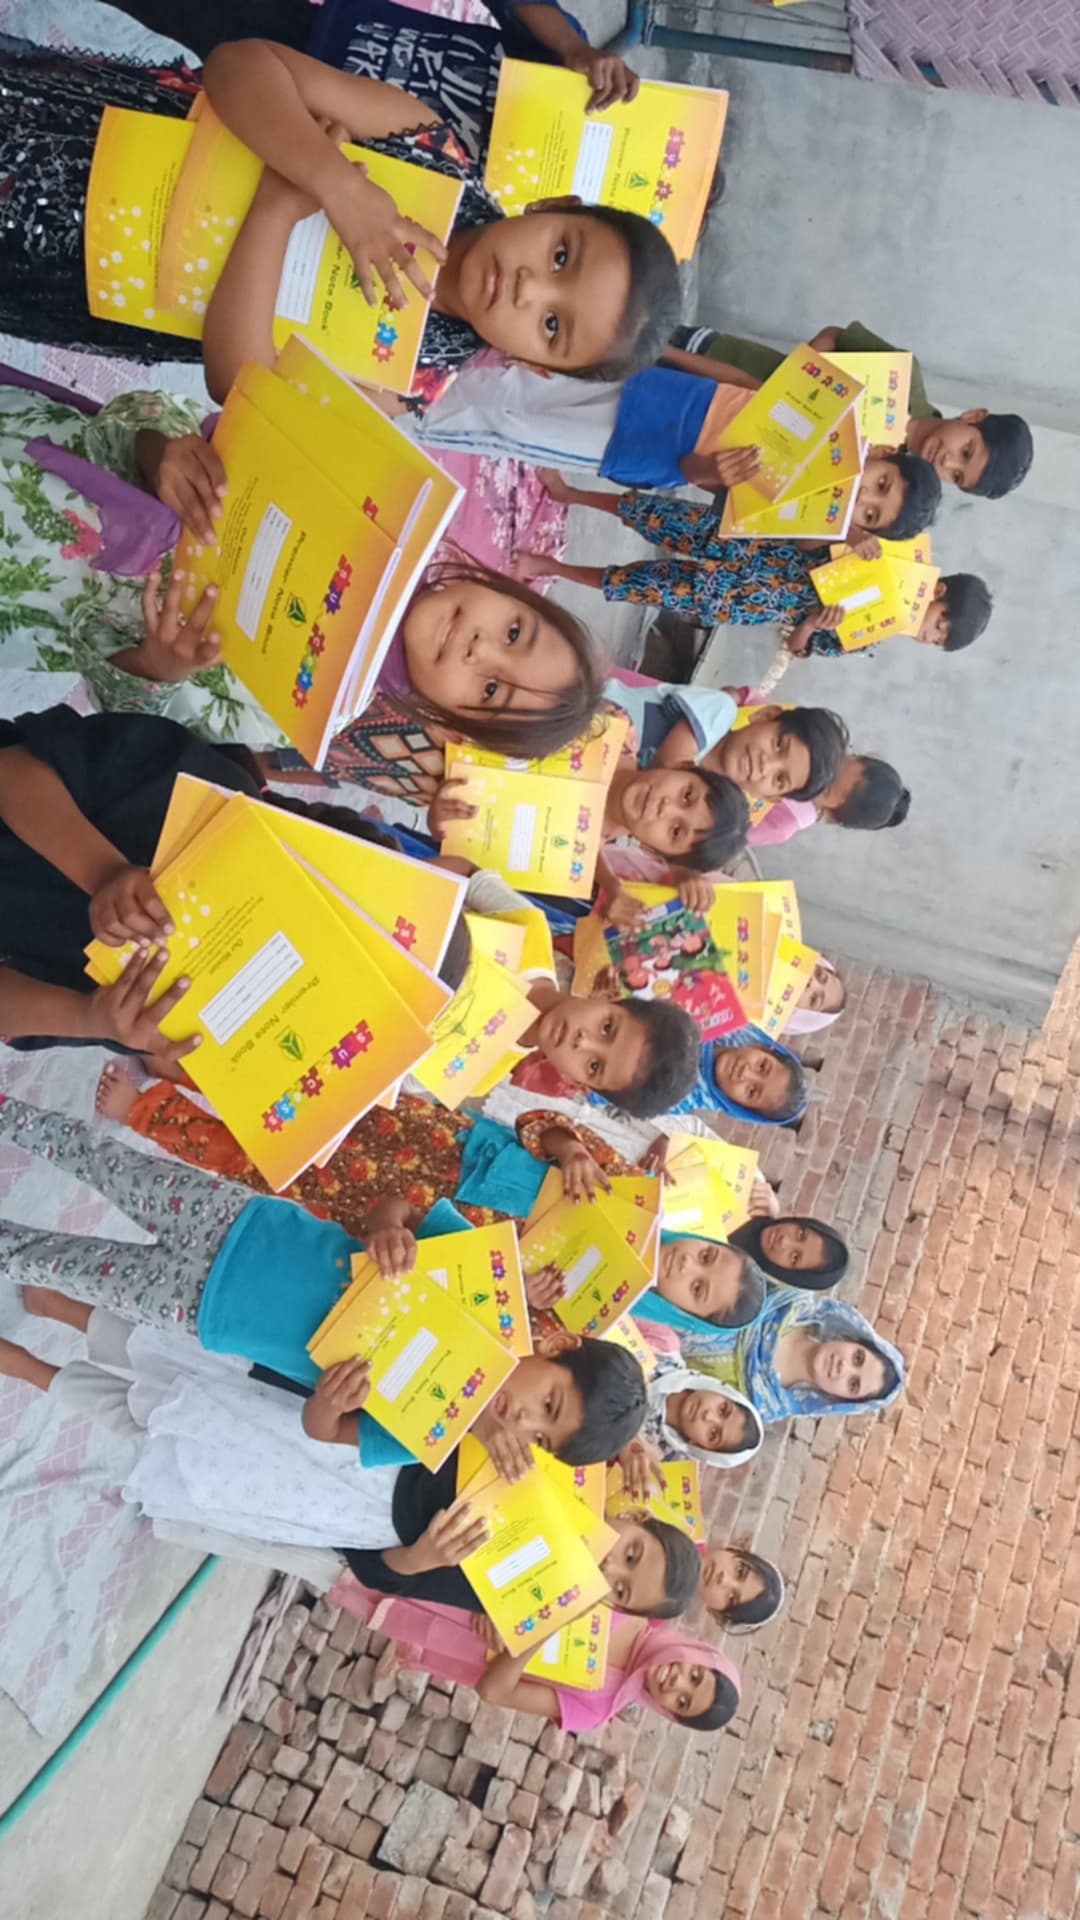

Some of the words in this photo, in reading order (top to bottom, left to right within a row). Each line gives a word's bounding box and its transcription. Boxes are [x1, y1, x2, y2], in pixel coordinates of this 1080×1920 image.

[327, 264, 341, 297] Note
[320, 301, 333, 331] Book
[281, 976, 320, 1014] Premier
[254, 1015, 281, 1039] Note
